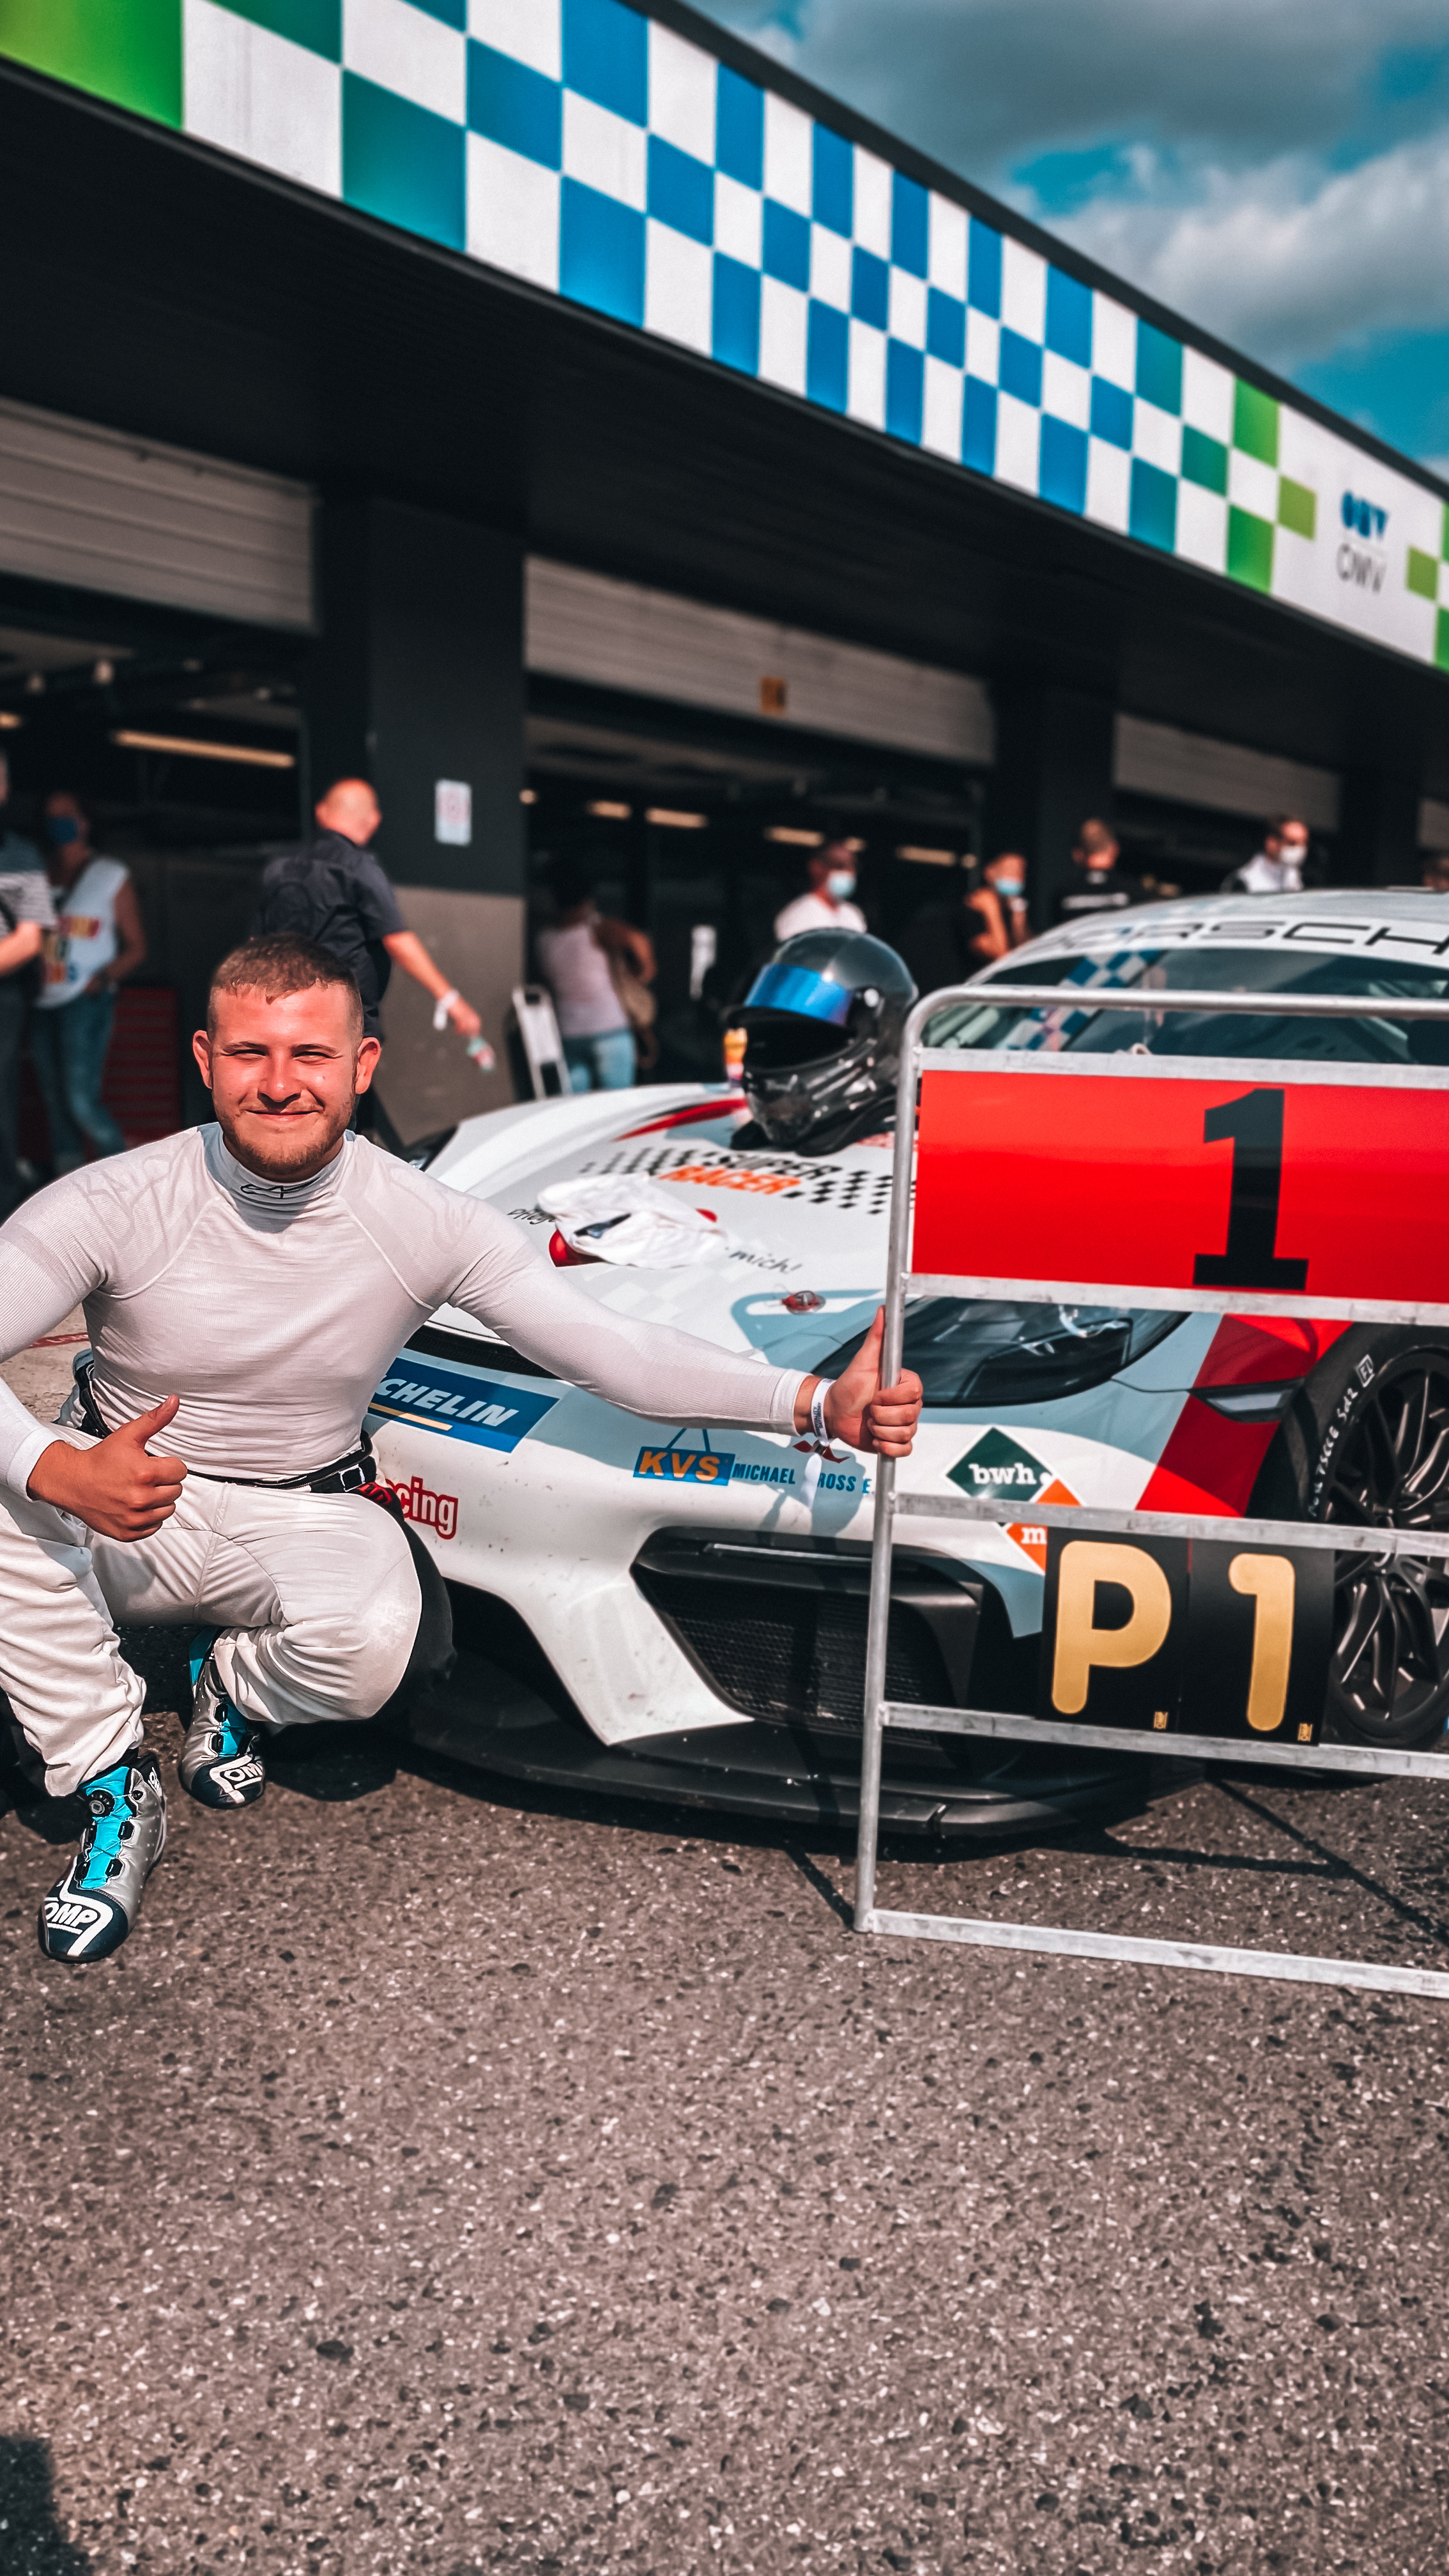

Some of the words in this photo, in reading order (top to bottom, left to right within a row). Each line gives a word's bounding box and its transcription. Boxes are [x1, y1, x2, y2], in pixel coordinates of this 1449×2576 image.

[658, 1165, 802, 1195] RACER
[1193, 1089, 1309, 1291] 1
[375, 1377, 519, 1427] CHELIN
[639, 1450, 721, 1482] KVS
[731, 1462, 796, 1485] MICHAEL
[817, 1472, 857, 1492] ROSS
[387, 1475, 459, 1540] cing
[224, 1763, 263, 1782] OM
[44, 1901, 98, 1928] OMP
